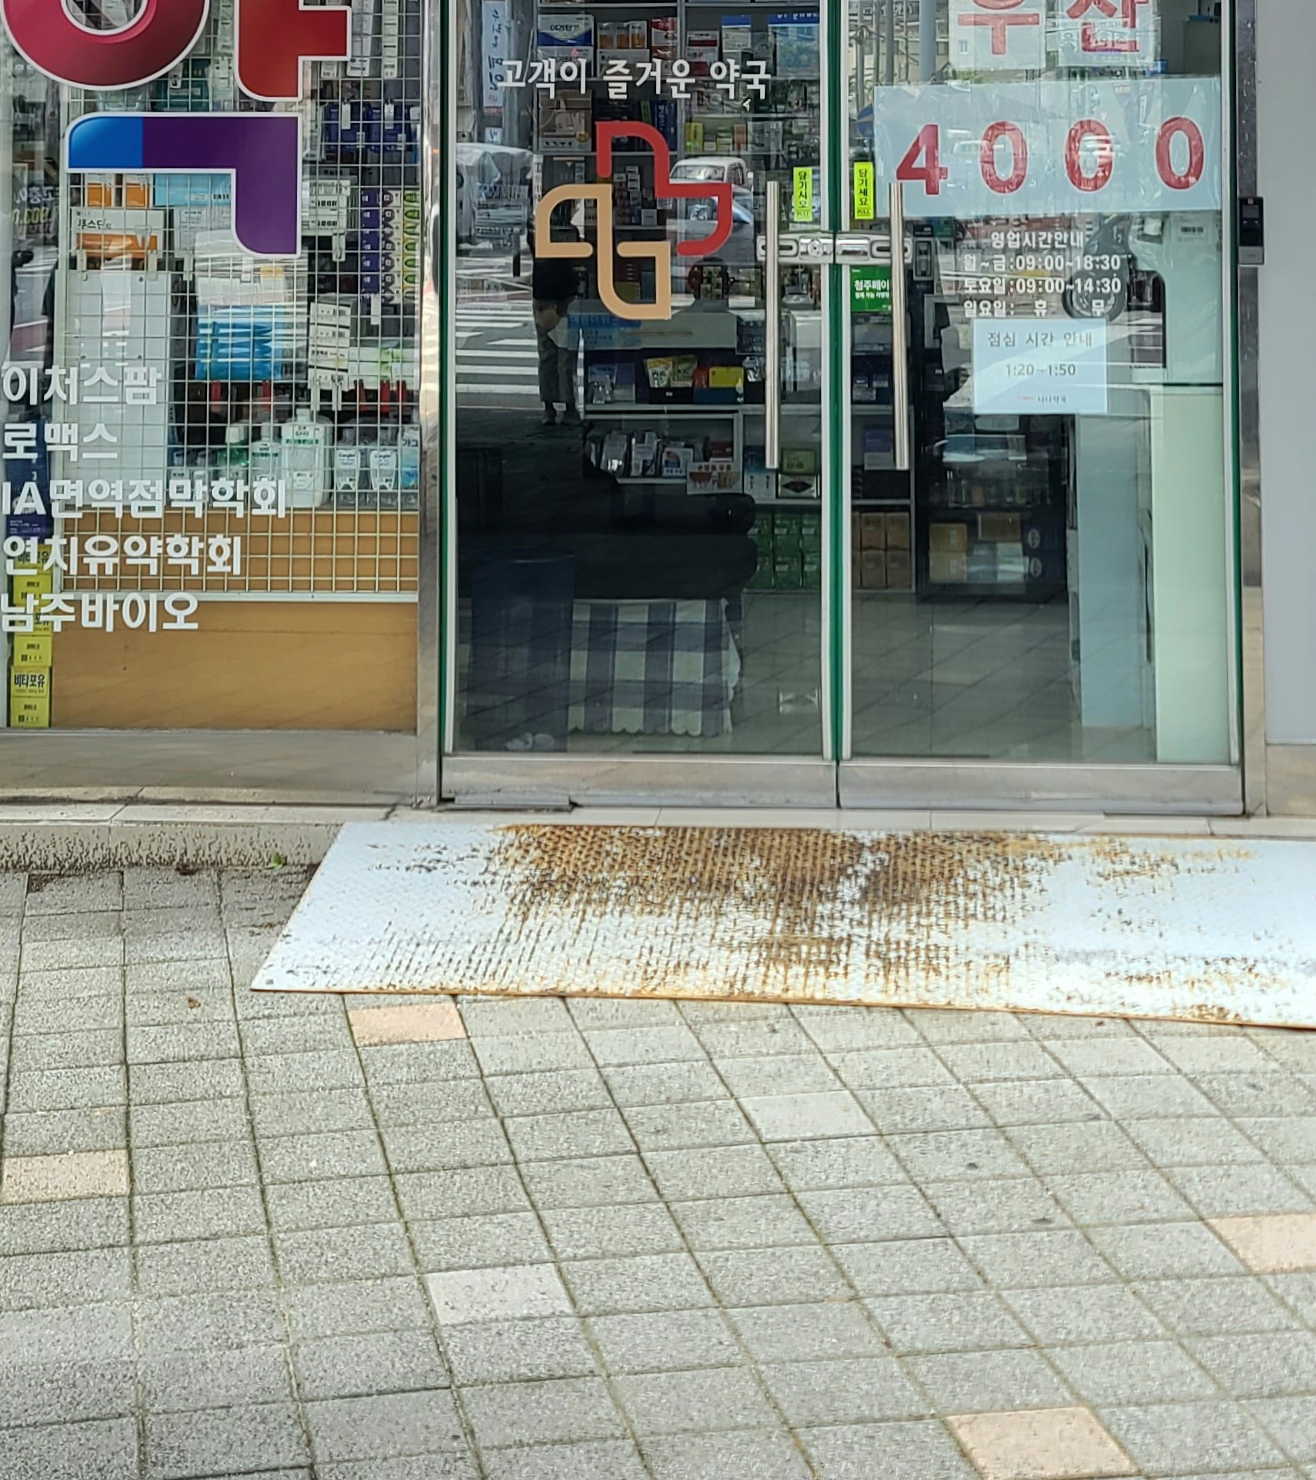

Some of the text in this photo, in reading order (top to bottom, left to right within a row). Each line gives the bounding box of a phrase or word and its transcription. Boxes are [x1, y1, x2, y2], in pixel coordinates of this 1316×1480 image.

[498, 58, 772, 100] 고객이 즐거운 약국
[895, 116, 1205, 196] 4000
[858, 168, 869, 206] 당기세요
[991, 231, 1084, 249] 영업시간안내
[853, 279, 890, 292] 청주페이
[988, 331, 1092, 348] 점심 시간 안내
[14, 673, 45, 688] 비타포유
